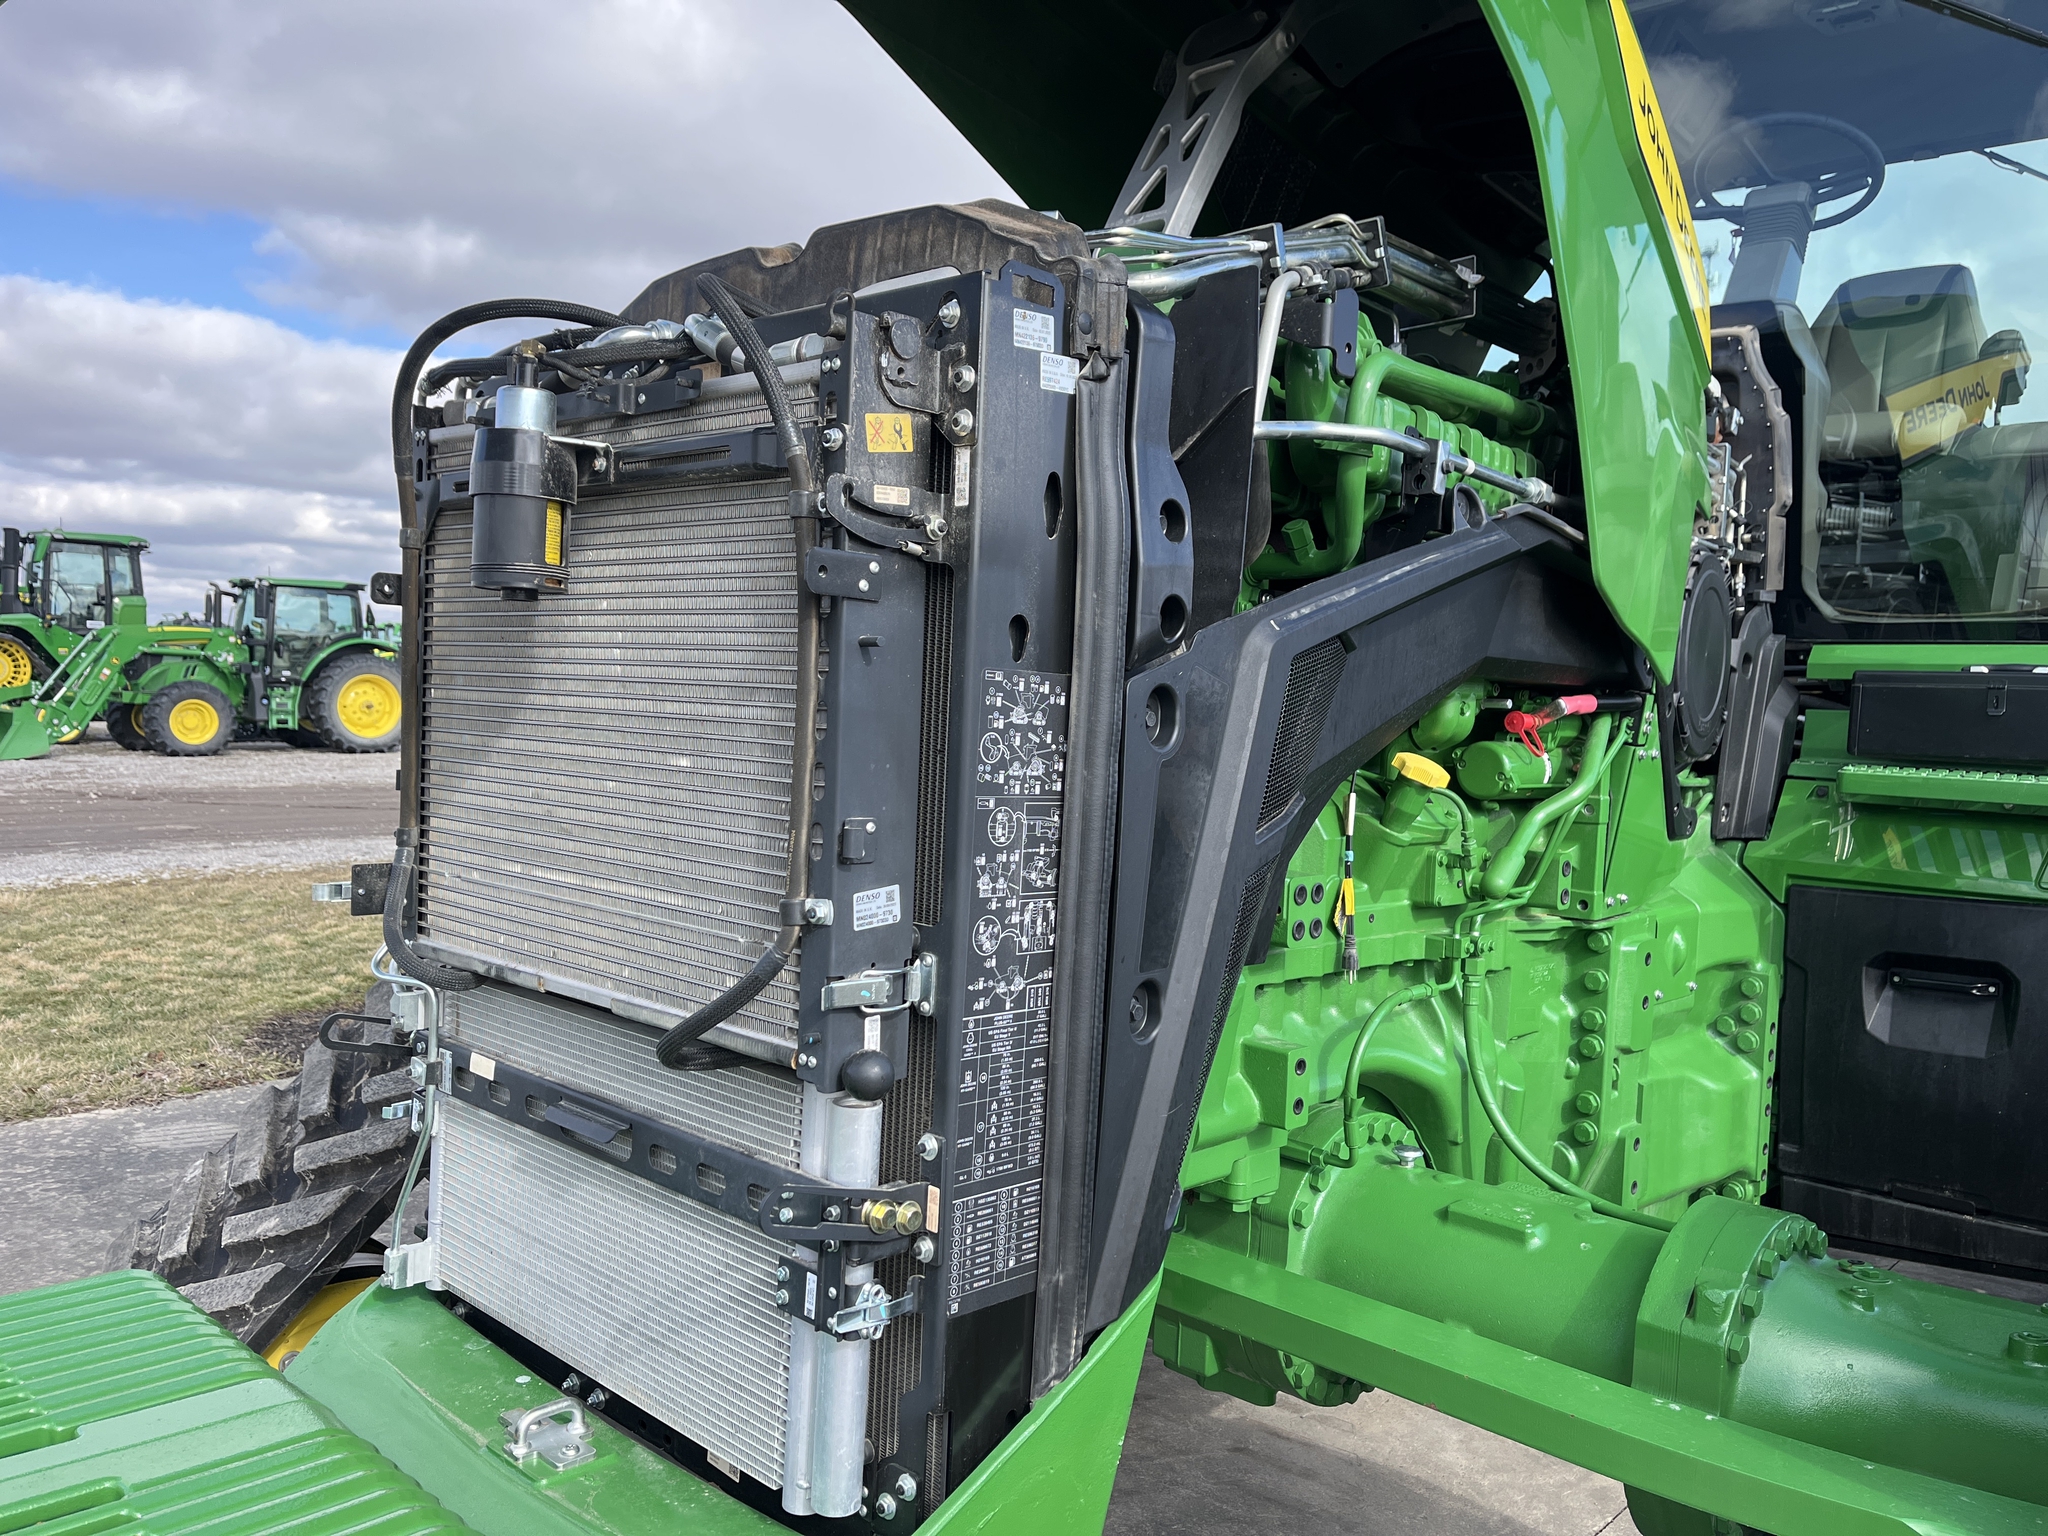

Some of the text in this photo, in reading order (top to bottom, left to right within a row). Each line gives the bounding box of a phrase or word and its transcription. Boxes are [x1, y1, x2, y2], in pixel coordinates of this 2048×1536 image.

[1638, 79, 1707, 322] JOHN DEERE
[1015, 311, 1036, 321] DESO
[1043, 356, 1063, 366] DENSO
[856, 892, 880, 902] DENSO
